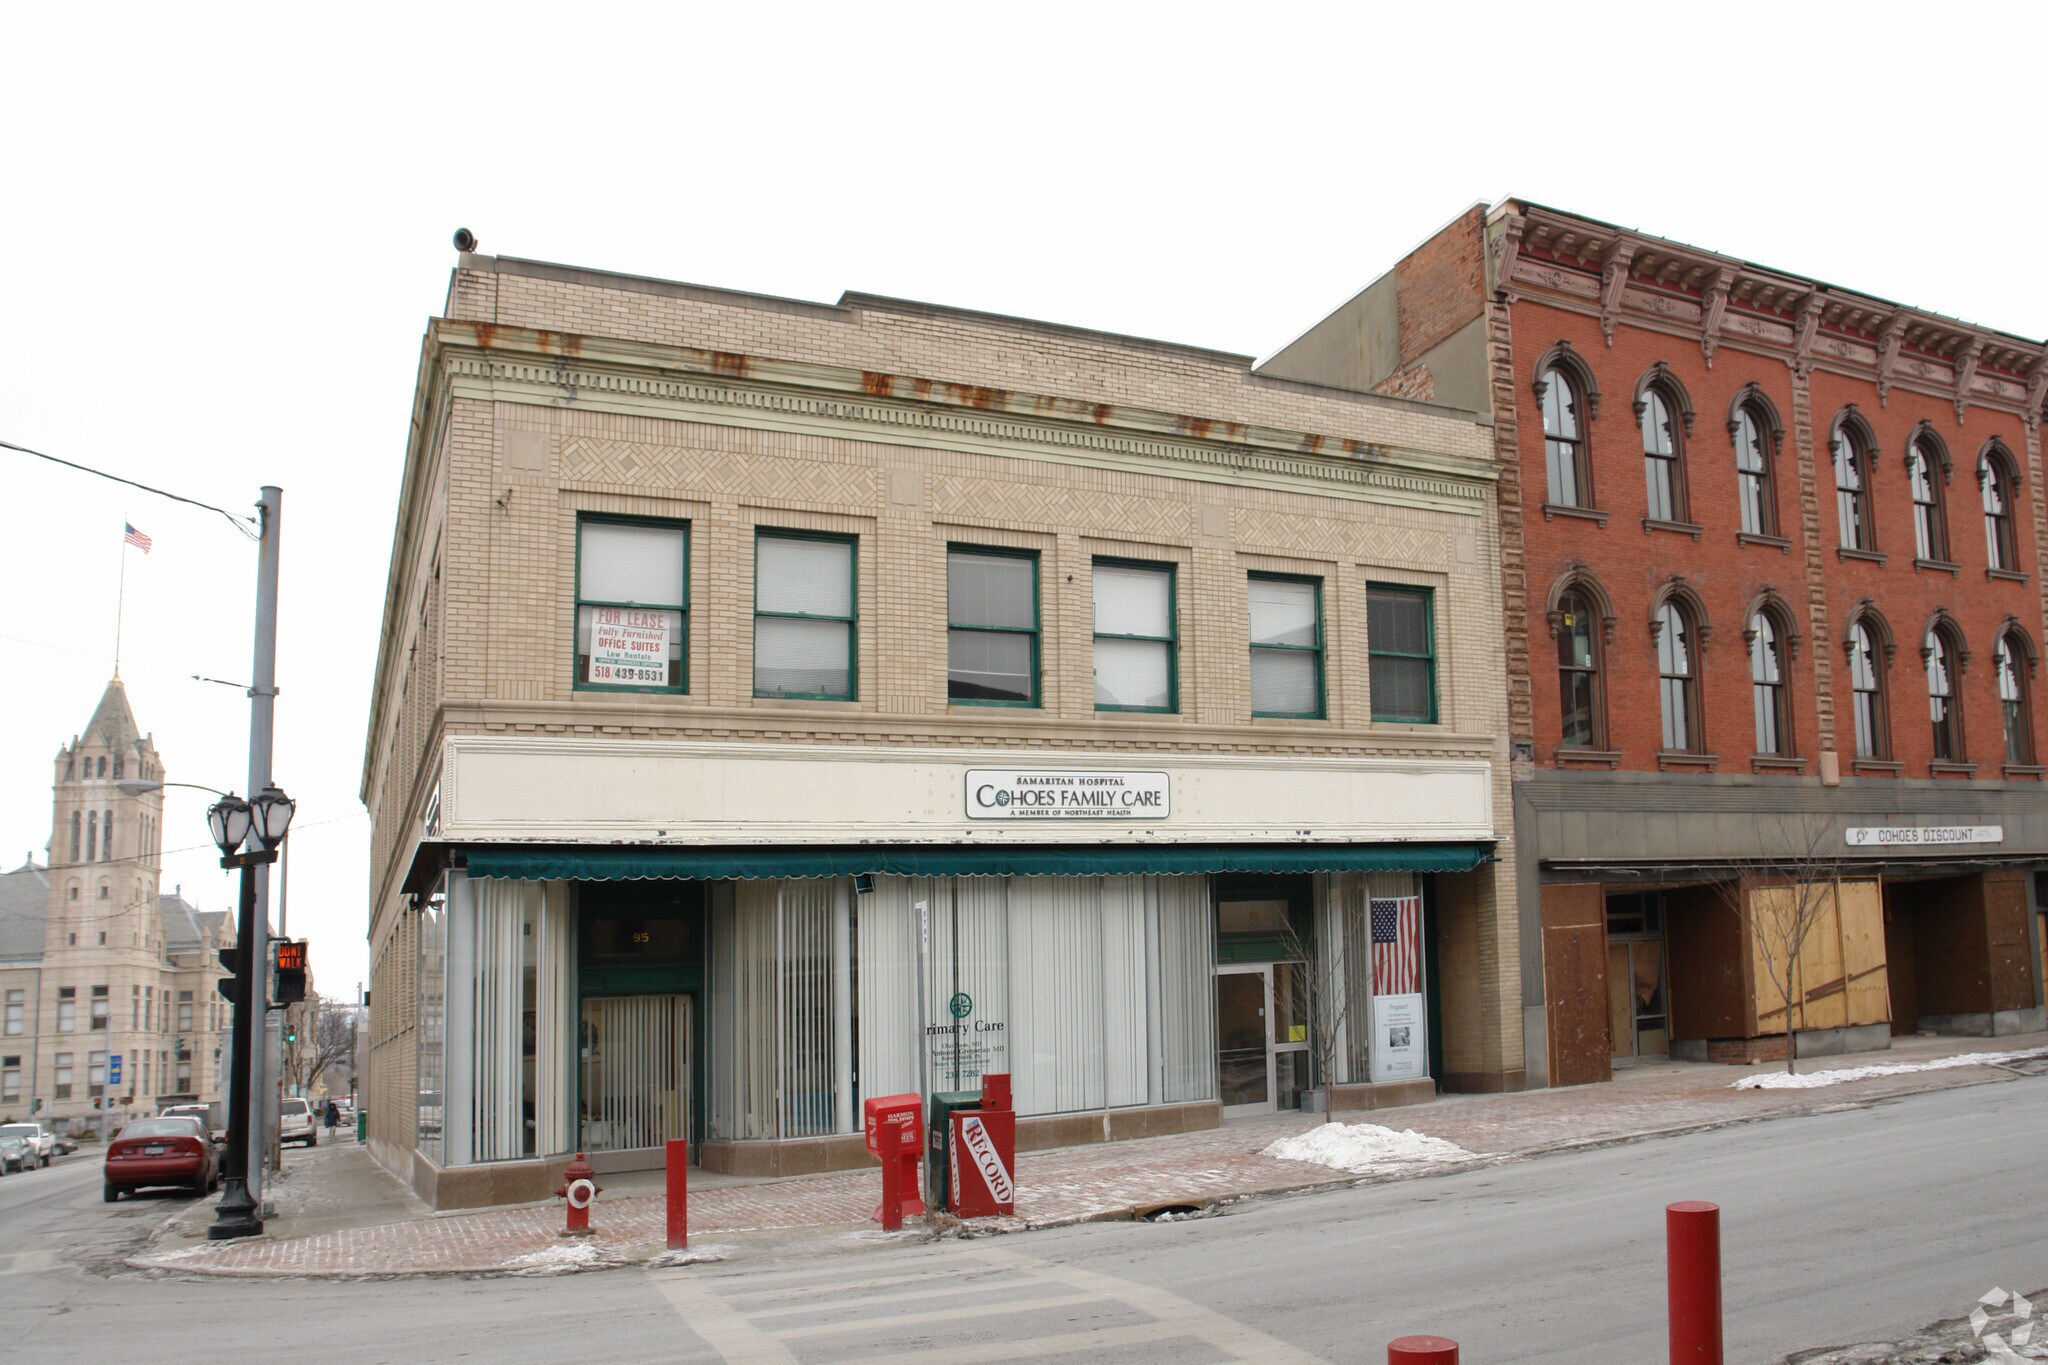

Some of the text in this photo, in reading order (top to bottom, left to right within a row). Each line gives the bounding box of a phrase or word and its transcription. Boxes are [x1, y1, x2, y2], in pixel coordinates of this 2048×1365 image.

[598, 608, 664, 628] FOR LEASE
[598, 626, 663, 640] Fully Furnished
[598, 637, 660, 652] OFFICE SUITES
[606, 650, 651, 660] Low Rentals
[1016, 777, 1125, 786] SAMARITAN HOSPITAL
[1061, 790, 1117, 807] FAMILY
[1121, 790, 1162, 807] CARE
[1878, 829, 1919, 842] COHOES
[1924, 828, 1974, 842] DISCOUNT
[633, 932, 650, 943] 95
[278, 957, 302, 969] WALK
[926, 1020, 1004, 1036] rimary Care
[965, 1123, 1012, 1202] RECORD
